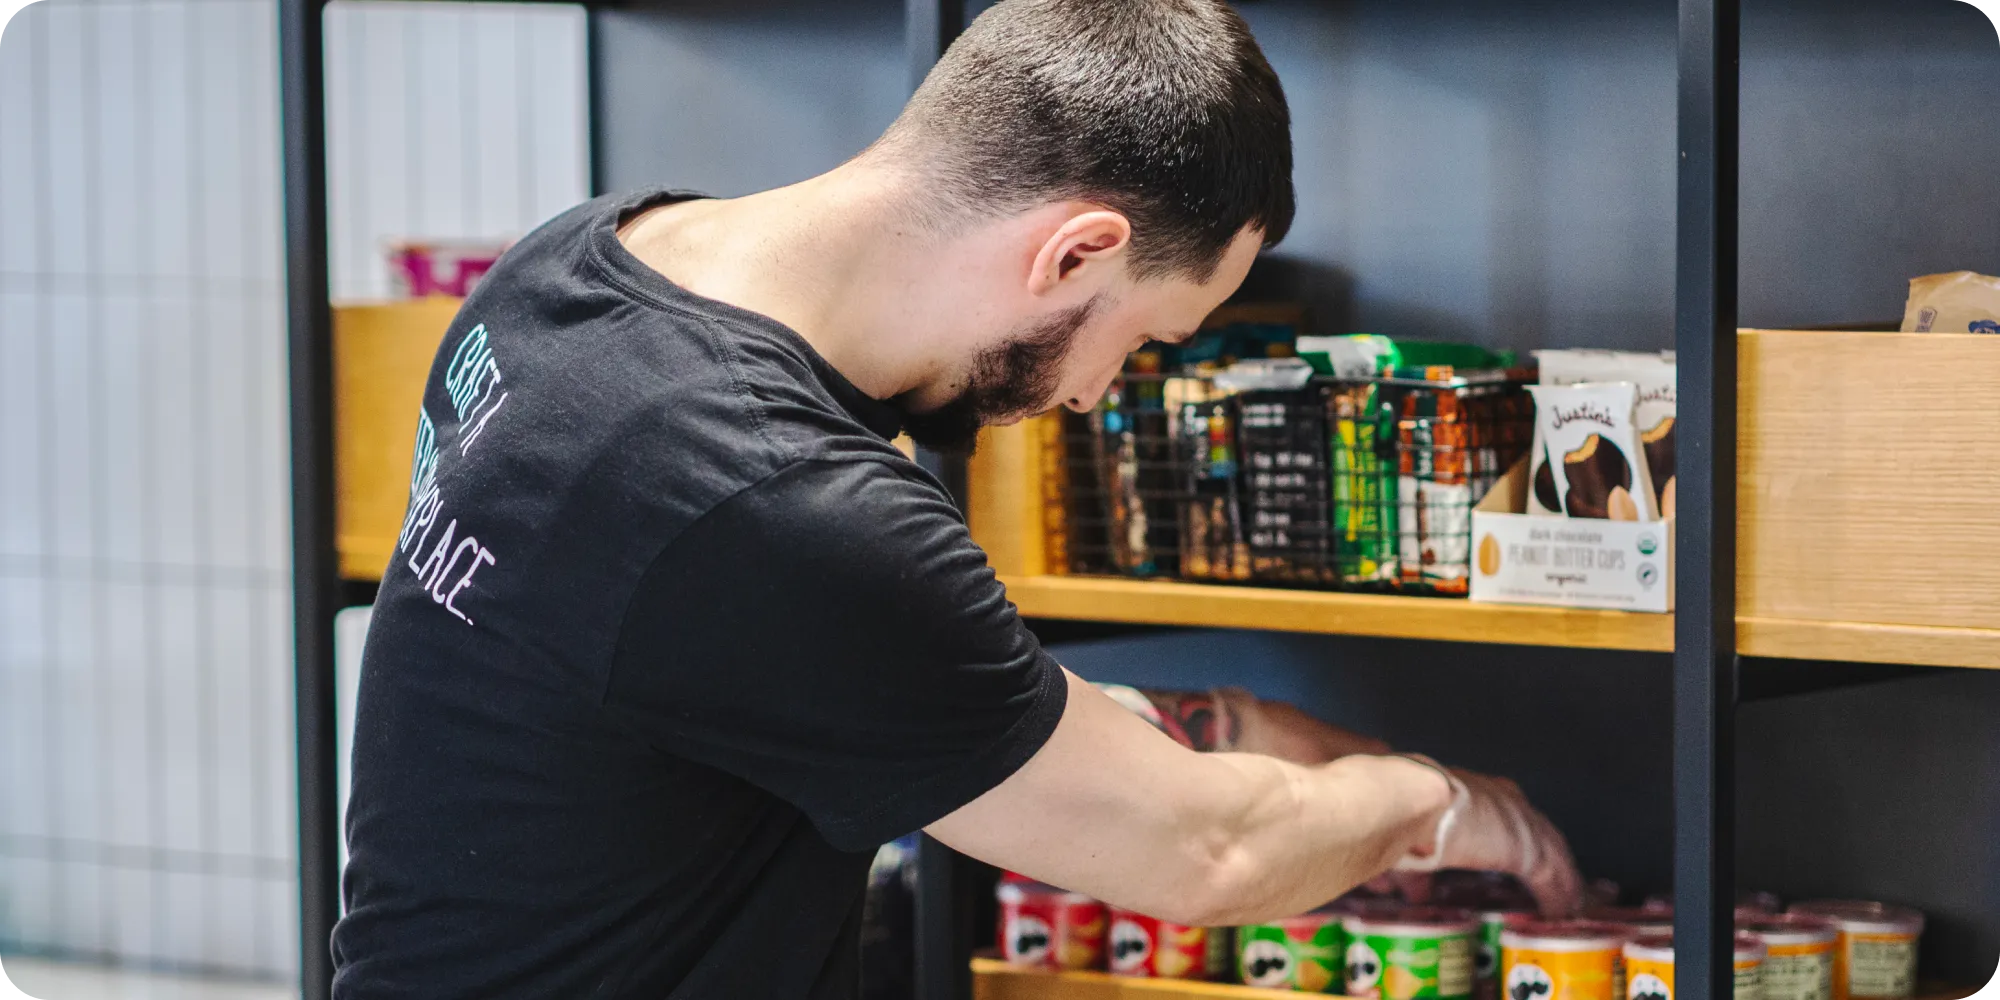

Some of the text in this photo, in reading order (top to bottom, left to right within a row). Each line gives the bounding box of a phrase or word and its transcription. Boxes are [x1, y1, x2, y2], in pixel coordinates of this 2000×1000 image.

[445, 322, 508, 457] CRAFT A
[1552, 402, 1614, 430] Justin's
[1528, 527, 1603, 544] dark chocolate
[1507, 543, 1626, 571] PEANUT BUTTER CUPS
